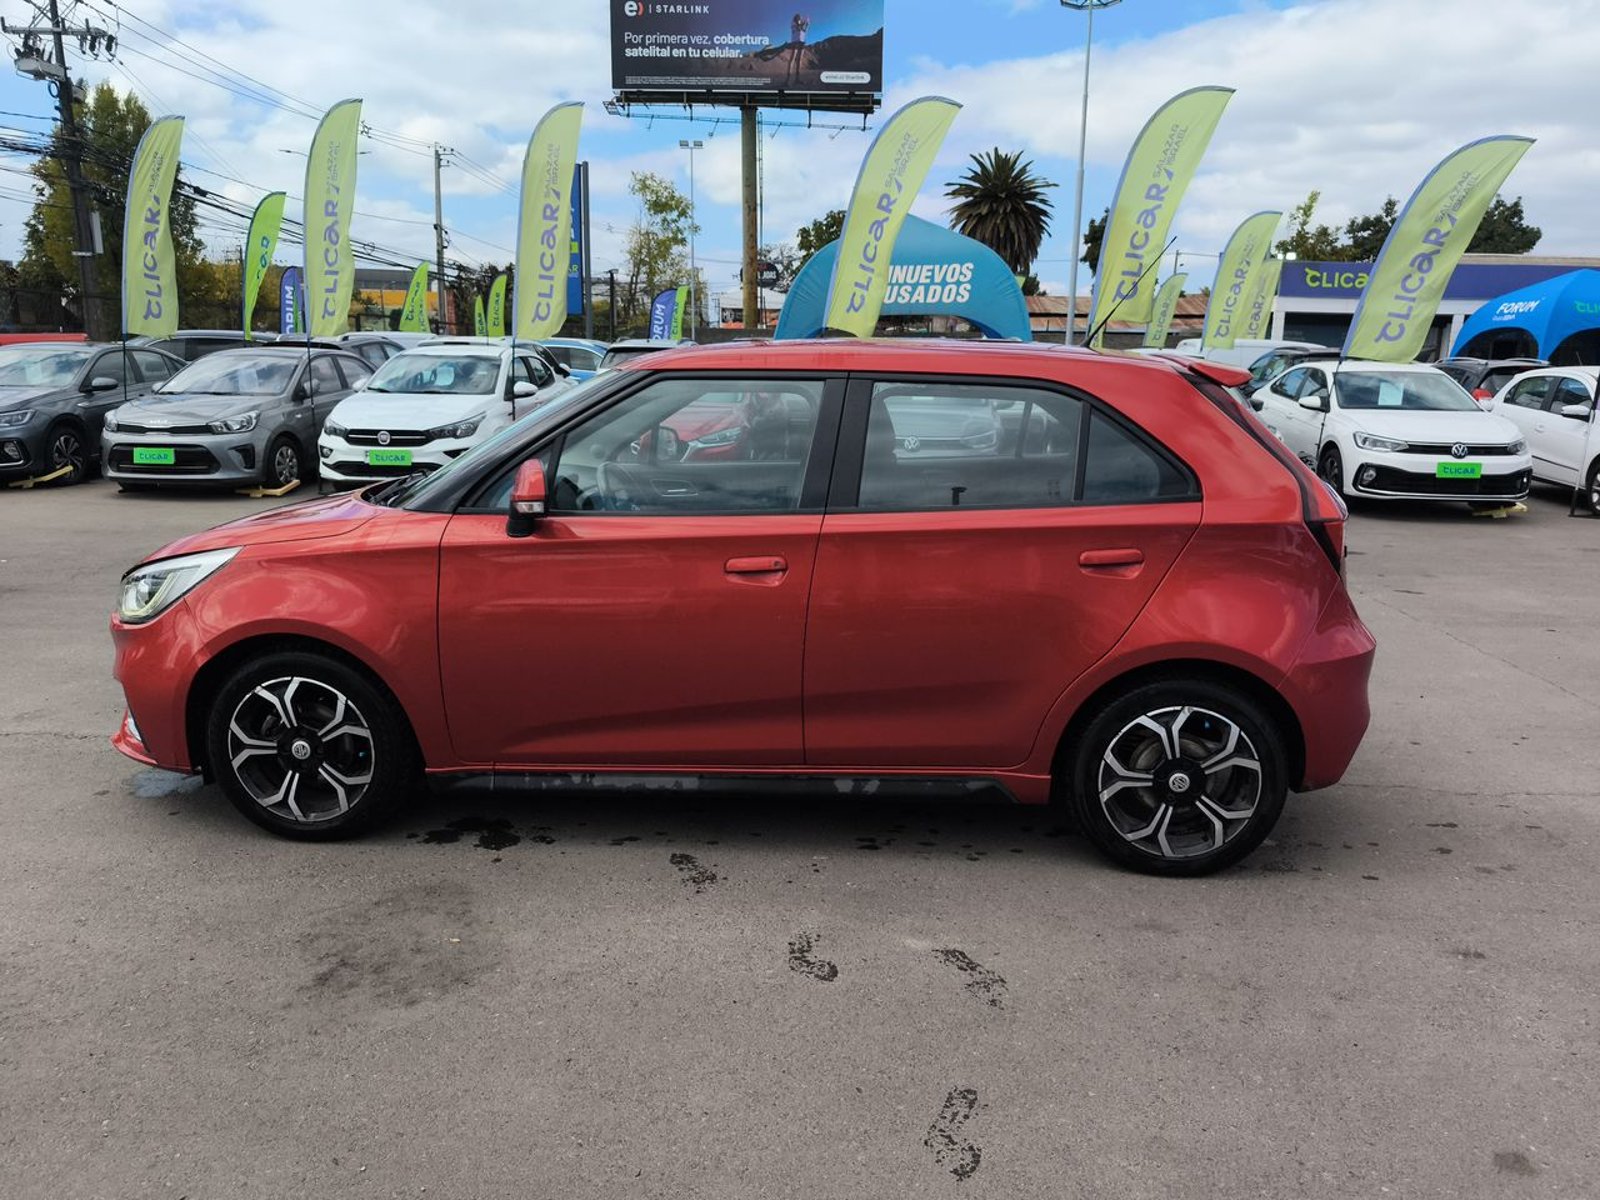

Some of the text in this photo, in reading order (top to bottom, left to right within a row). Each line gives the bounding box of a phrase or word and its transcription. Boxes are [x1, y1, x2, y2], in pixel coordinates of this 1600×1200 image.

[655, 5, 710, 14] STARLINK
[624, 32, 770, 46] Por primera vez, cobertura
[624, 45, 743, 58] satelital en tu celular.
[884, 283, 972, 304] USADOS
[1496, 300, 1540, 315] FORUM
